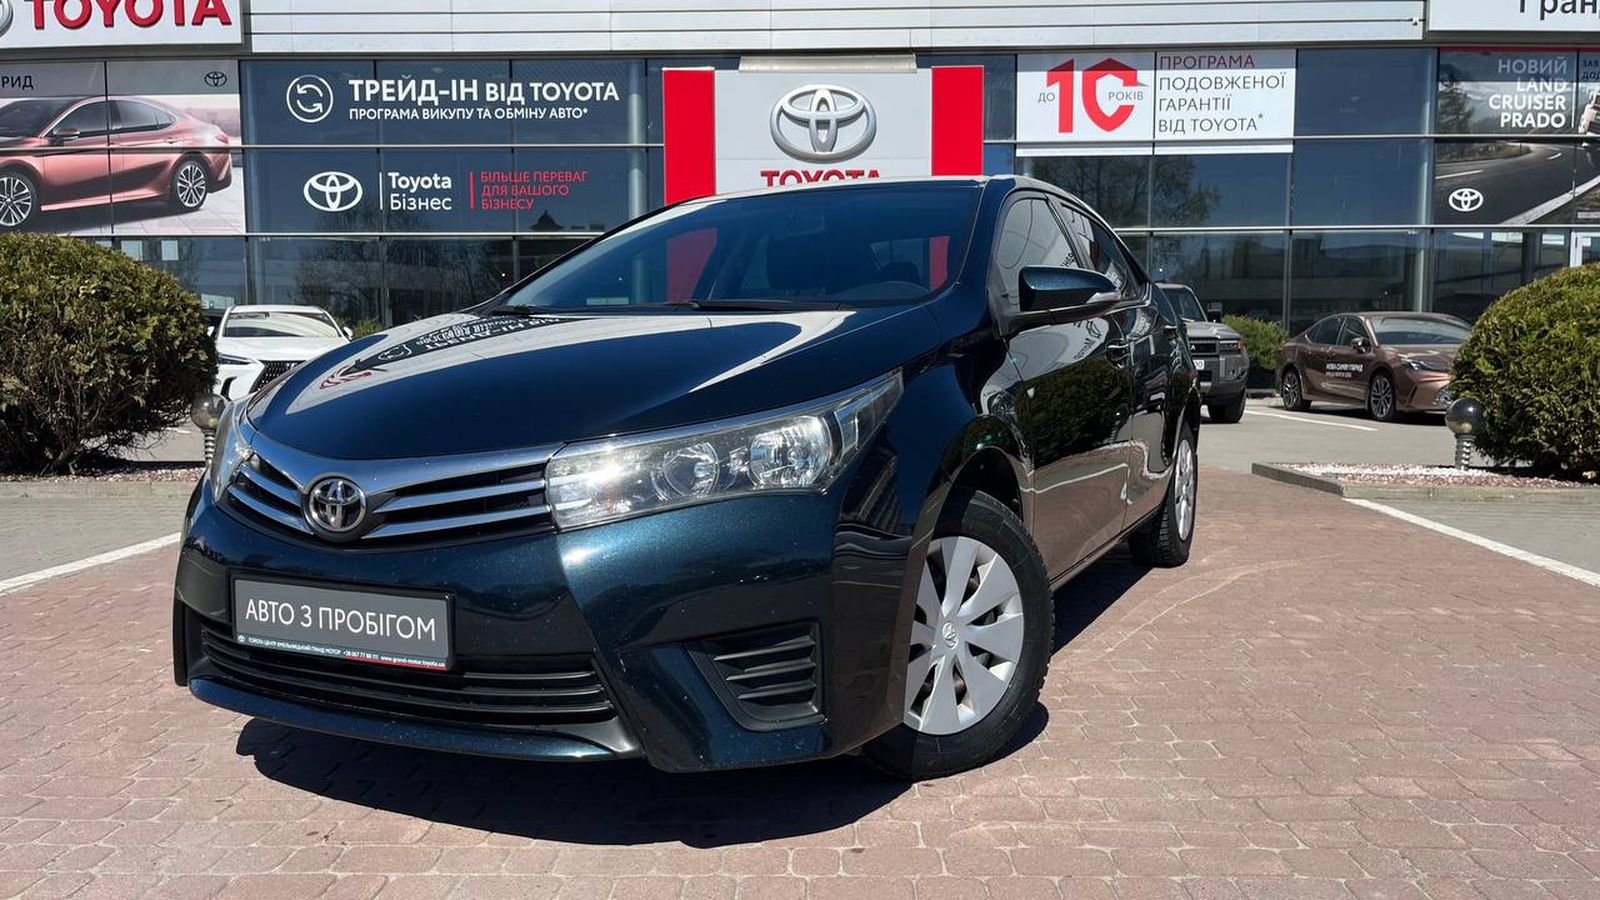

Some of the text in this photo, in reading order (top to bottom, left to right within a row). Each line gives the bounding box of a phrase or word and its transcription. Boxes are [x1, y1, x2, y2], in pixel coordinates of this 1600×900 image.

[24, 0, 232, 30] TOYOTA
[1519, 0, 1600, 20] Гран
[1160, 55, 1256, 70] ПРОГРАМА
[1498, 56, 1567, 74] НОВИЙ
[349, 75, 620, 105] ТРЕЙД-ІН ВІД TOYOTA
[1159, 71, 1288, 93] ПОДОВЖЕНОЇ
[1516, 77, 1567, 92] LAND
[1038, 92, 1056, 104] ДО
[1108, 91, 1144, 101] РОКІВ
[1158, 94, 1233, 112] ГАРАНТІЇ
[1489, 94, 1566, 110] CRUISER
[349, 108, 420, 120] ПРОГРАМА
[422, 108, 474, 120] ВИКУПУ
[476, 108, 492, 120] ТА
[494, 108, 547, 120] ОБМІНУ
[1500, 112, 1566, 128] PRADO
[1158, 119, 1186, 135] ВІД
[388, 172, 452, 193] Toyota
[480, 171, 588, 182] БІЛЬШЕ ПЕРЕВАГ
[481, 185, 570, 197] ДЛЯ ВАШОГО
[390, 193, 453, 211] Бізнес
[481, 199, 535, 210] БІЗНЕСУ
[246, 599, 436, 641] АВТО З ПРОБІГОМ
